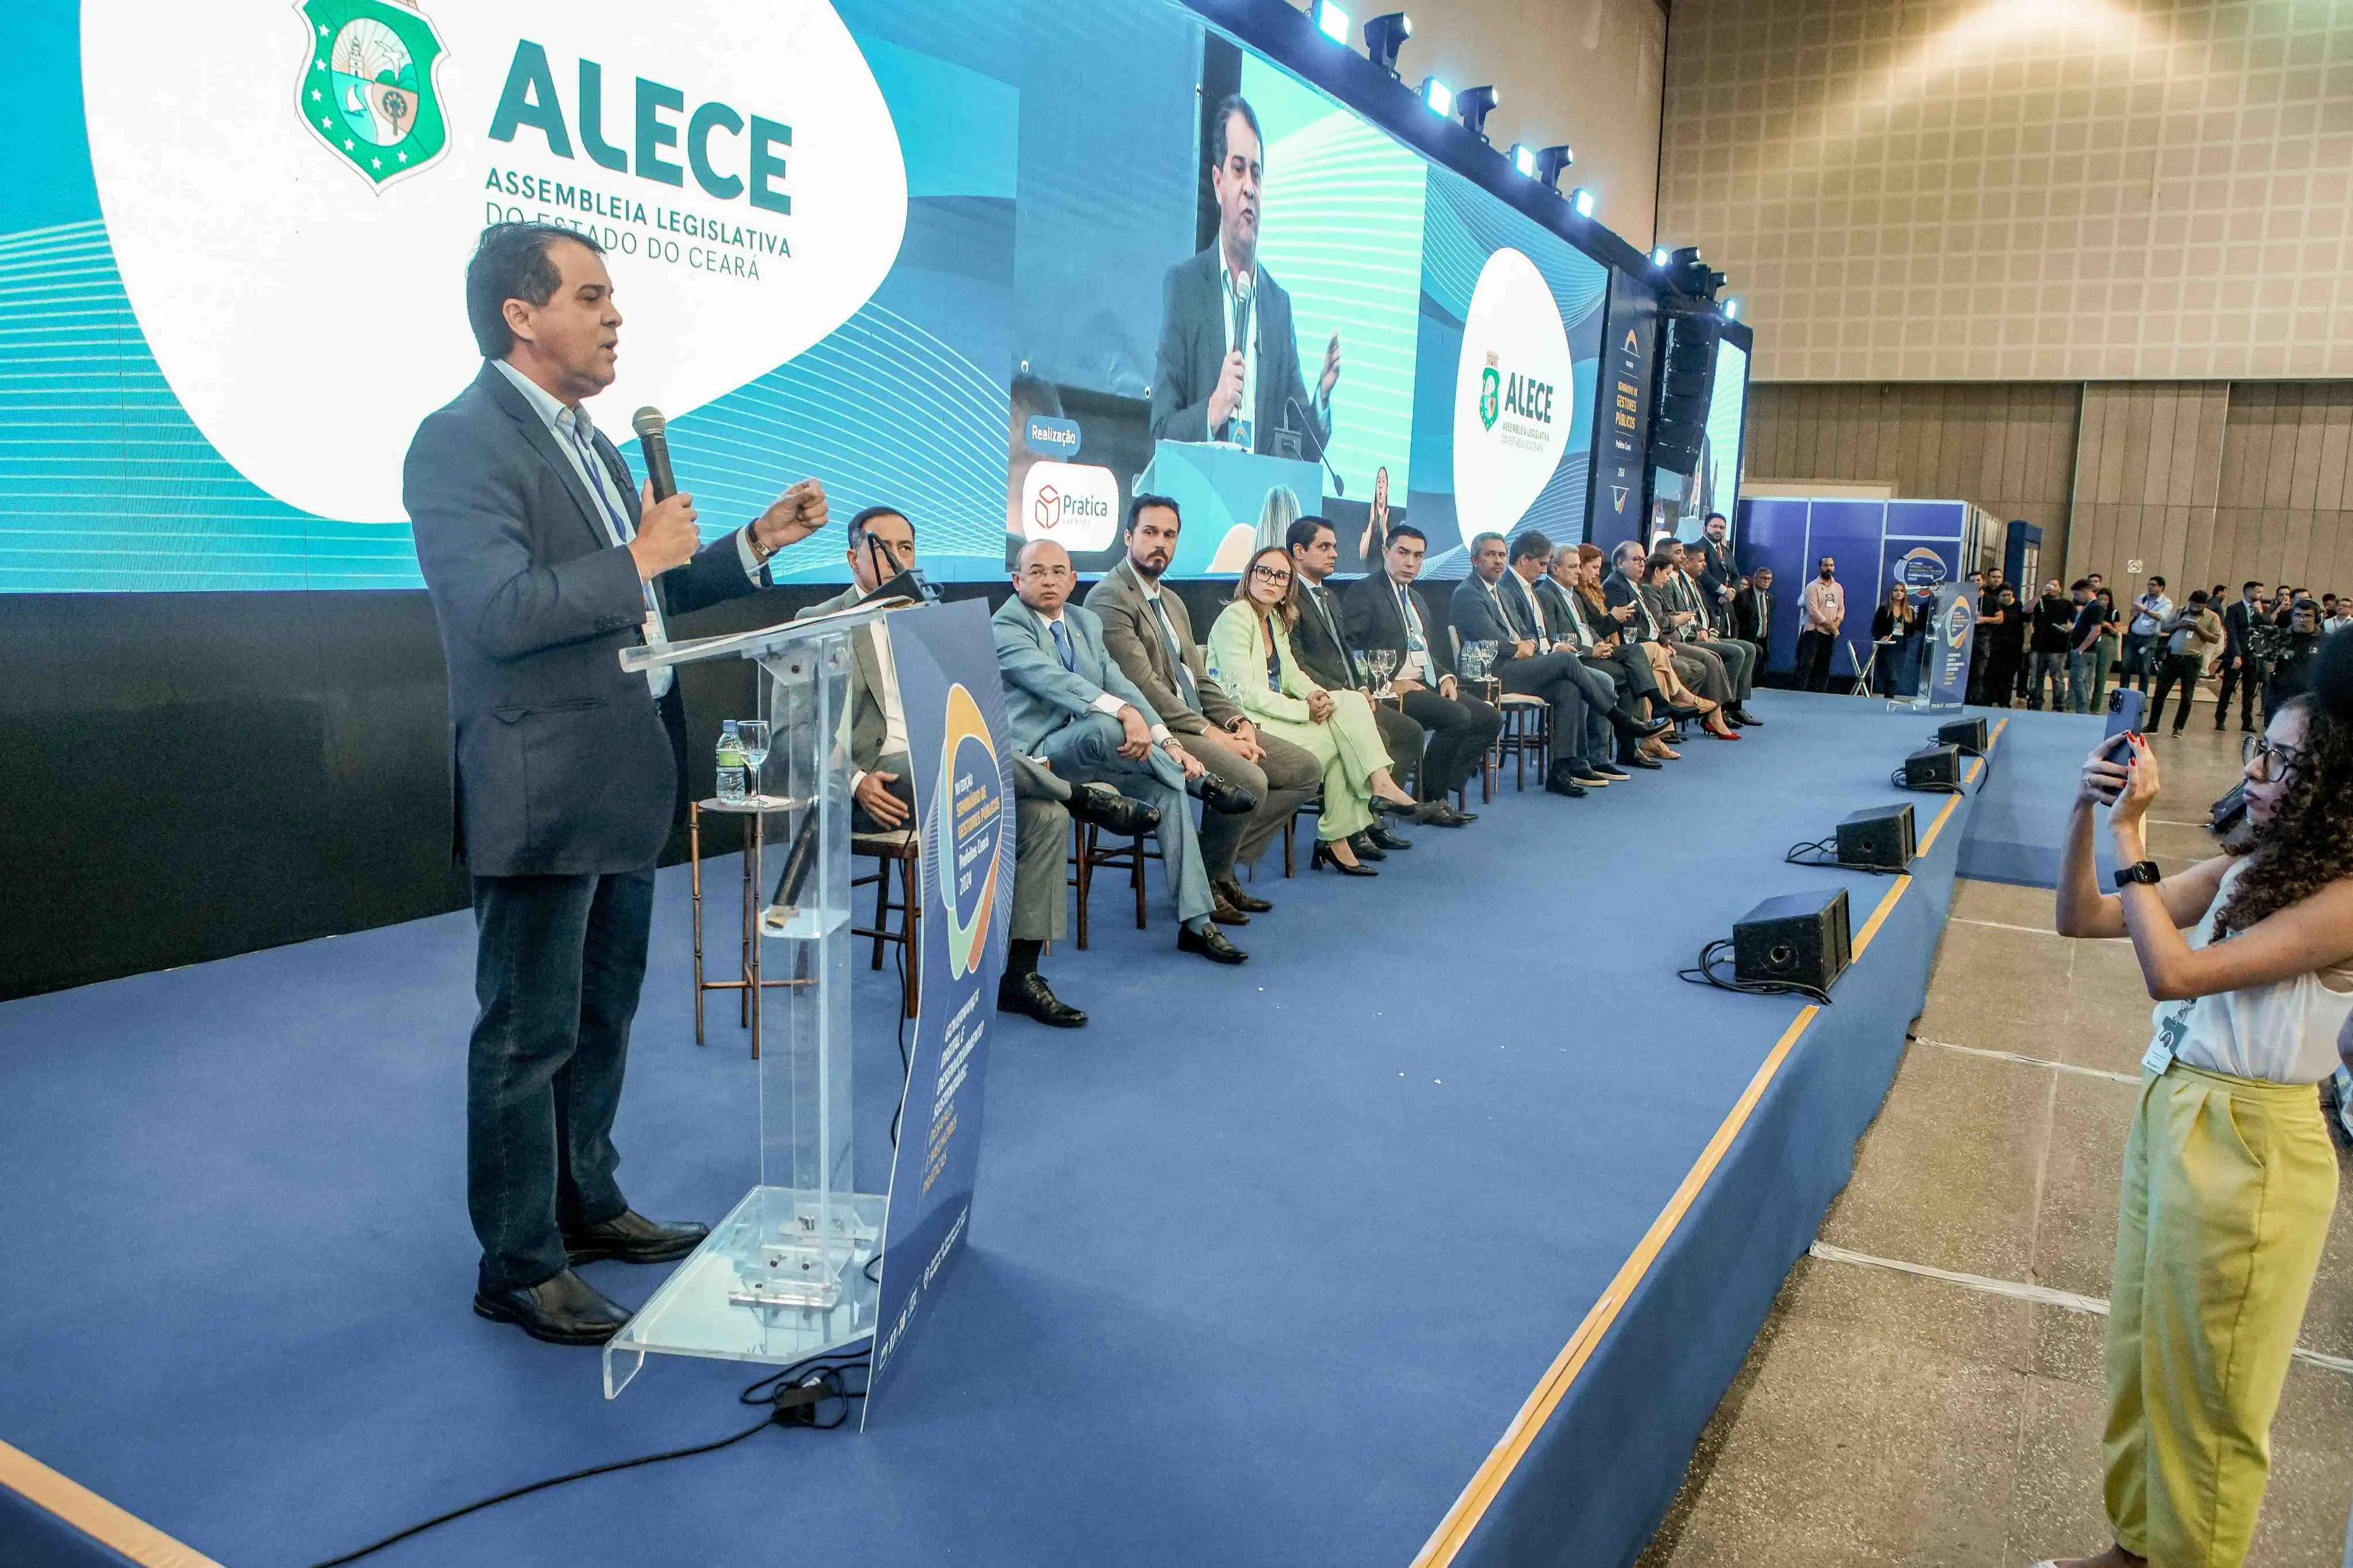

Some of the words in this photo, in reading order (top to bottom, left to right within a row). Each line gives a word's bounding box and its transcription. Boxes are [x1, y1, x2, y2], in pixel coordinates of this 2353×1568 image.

[488, 38, 792, 216] ALECE
[485, 167, 648, 225] ASSEMBLEIA
[657, 207, 791, 258] LEGISLATIVA
[648, 237, 680, 264] DO
[688, 247, 760, 280] CEARÁ
[1504, 372, 1554, 424] ALECE
[1617, 395, 1637, 413] GESTORES
[1502, 421, 1527, 436] ASSEMBLEIA
[1527, 428, 1549, 442] LEGISLATIVA
[1616, 410, 1635, 430] PÚBLICOS
[1032, 424, 1076, 448] Realização
[1064, 494, 1107, 517] Prática
